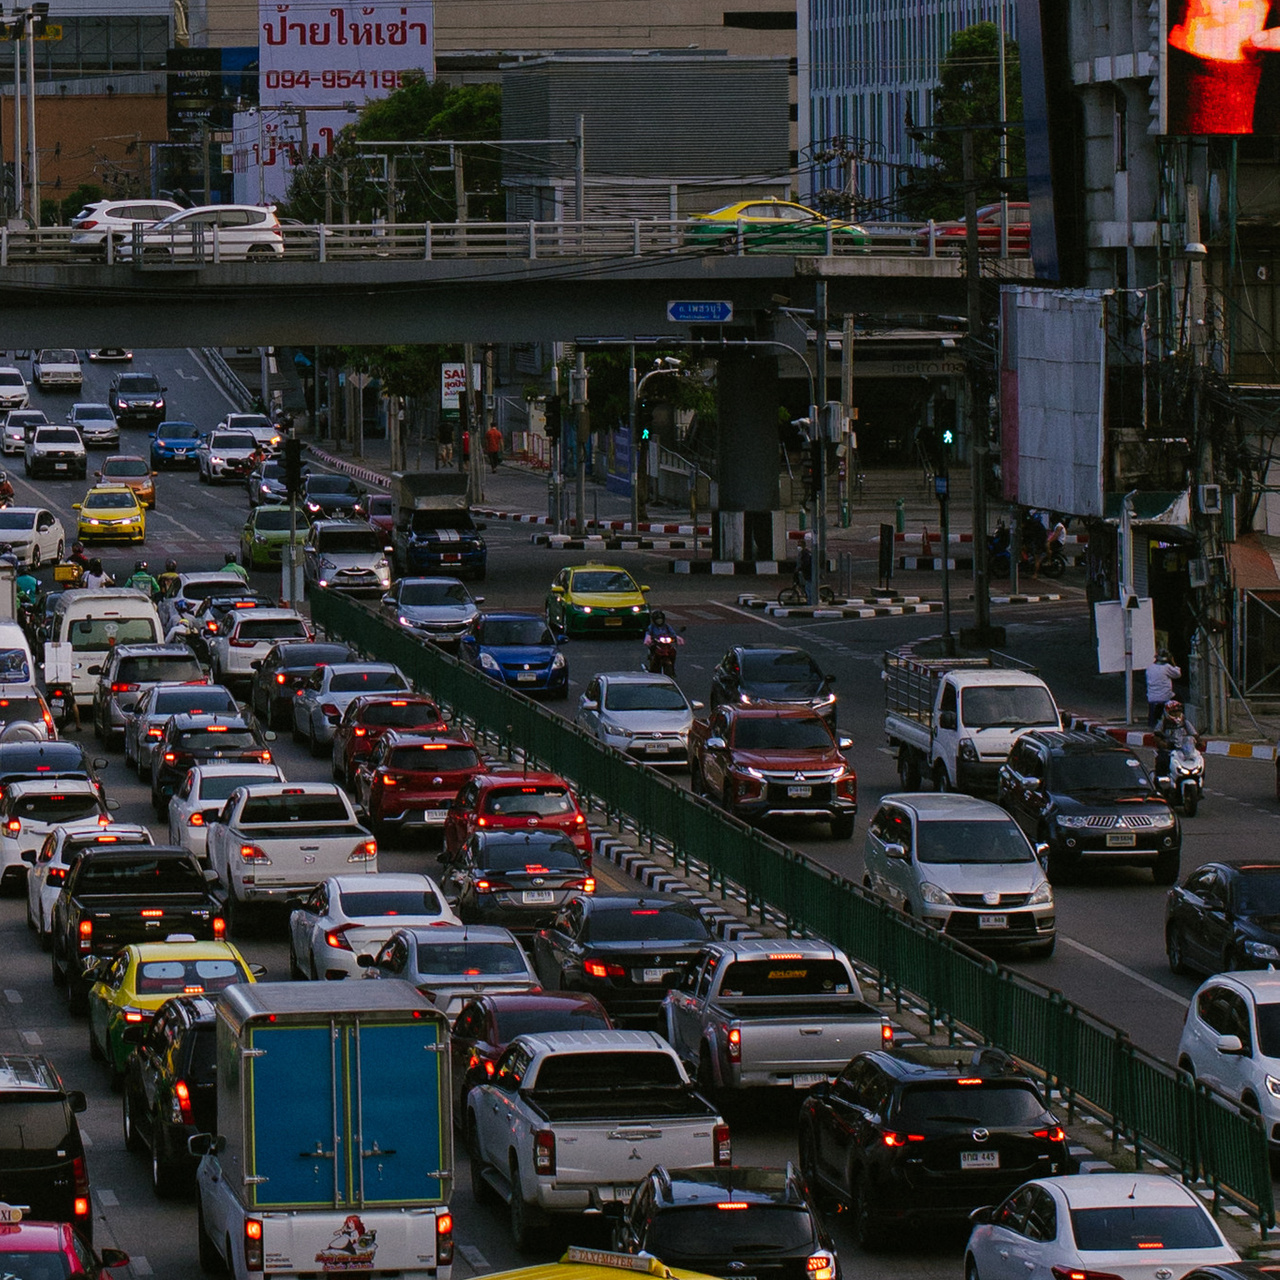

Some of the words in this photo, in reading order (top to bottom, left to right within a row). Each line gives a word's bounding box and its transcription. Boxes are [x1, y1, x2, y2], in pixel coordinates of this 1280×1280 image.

[263, 4, 427, 46] ป้ายให้เช่า
[892, 362, 939, 373] metro
[980, 1153, 995, 1162] 445
